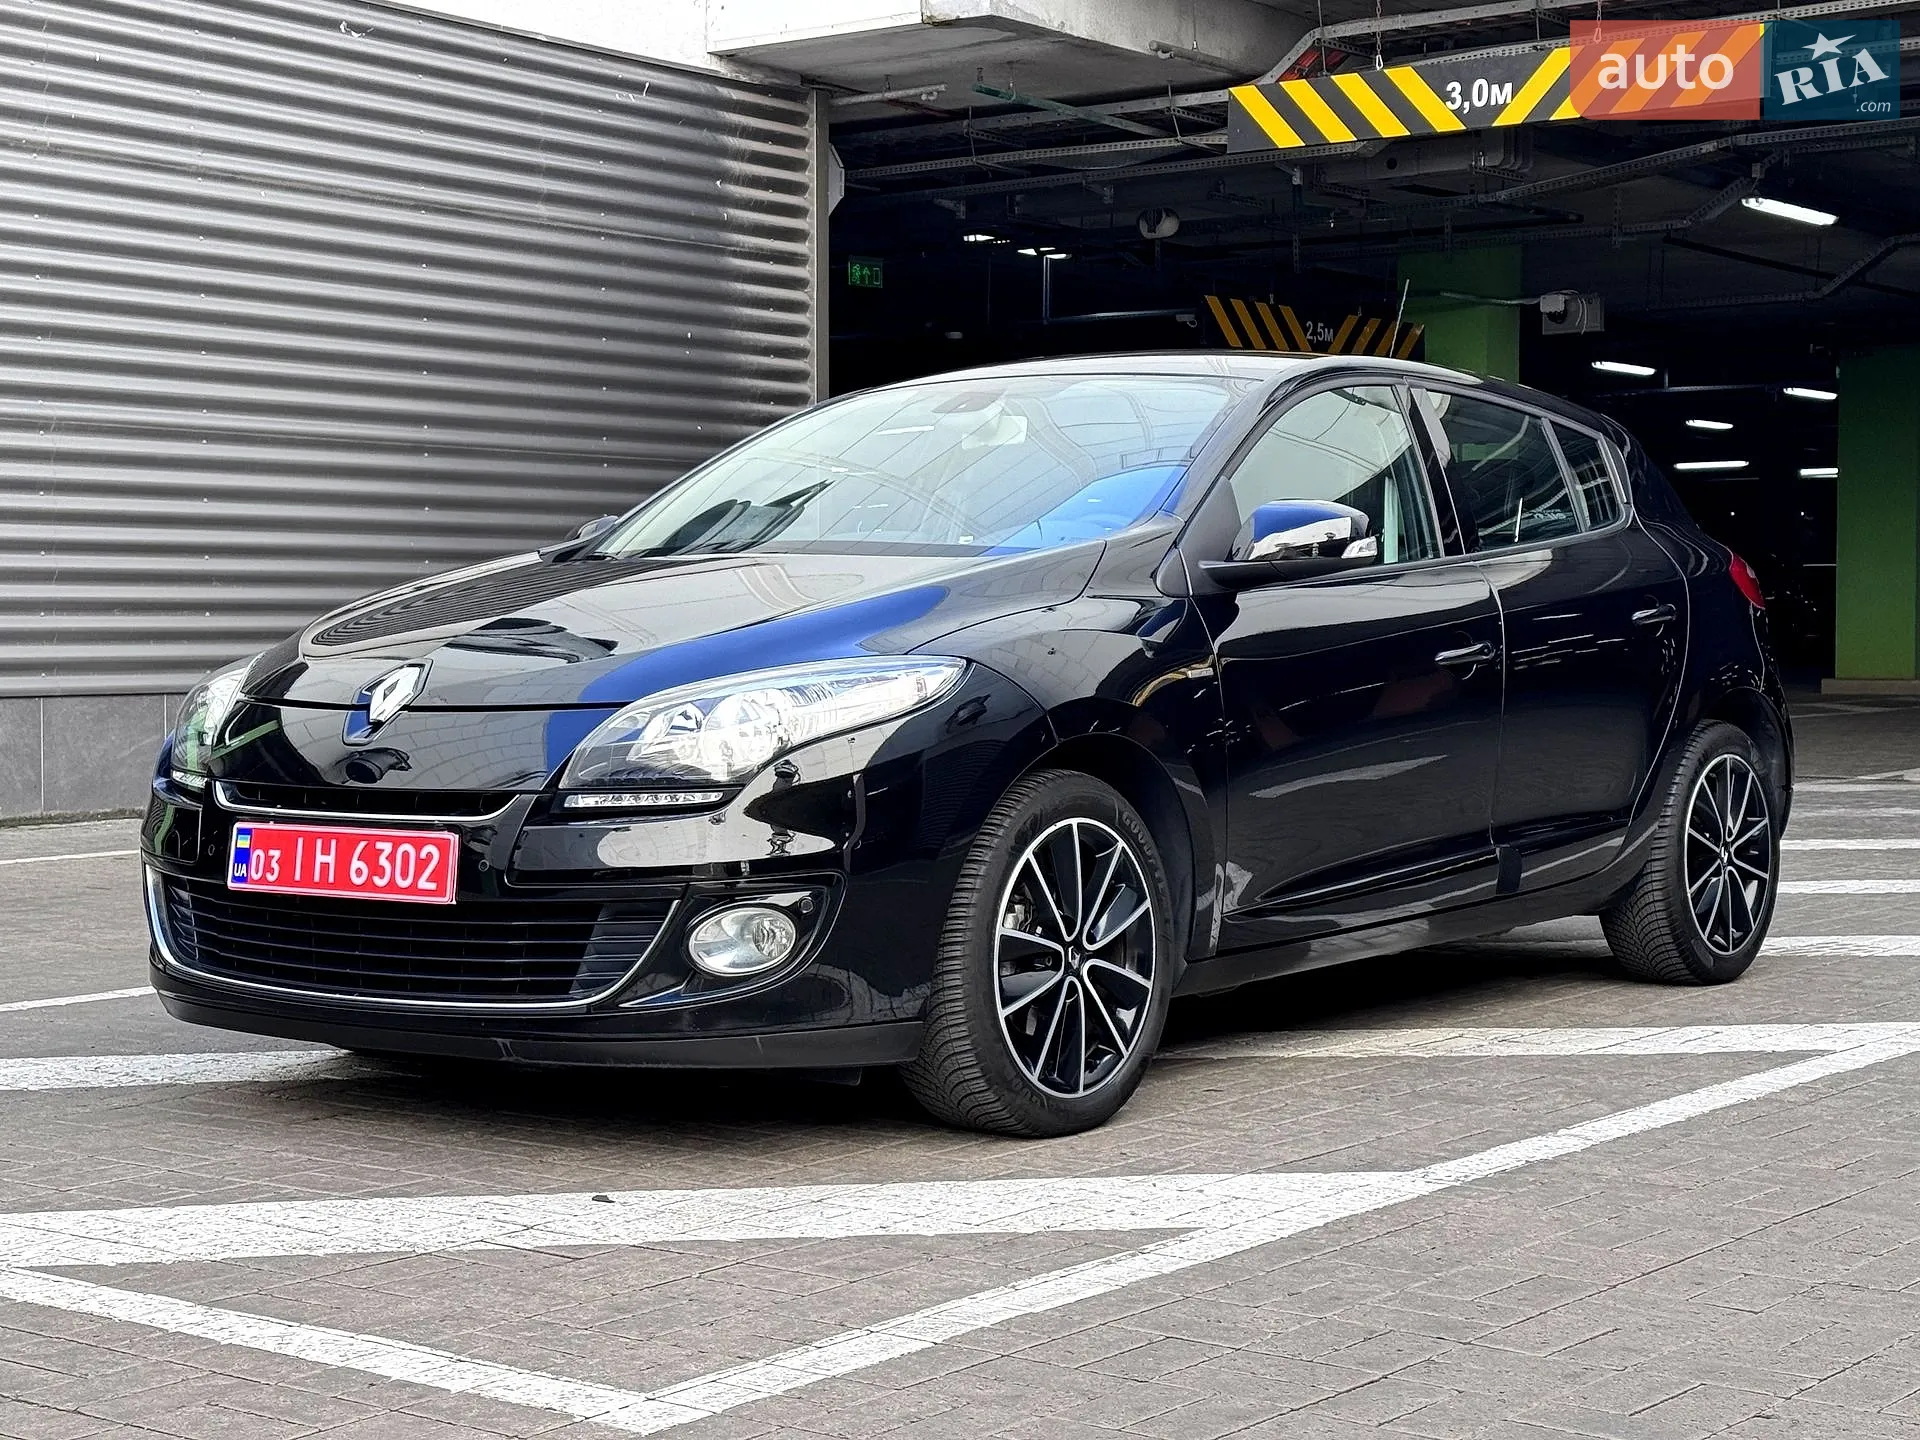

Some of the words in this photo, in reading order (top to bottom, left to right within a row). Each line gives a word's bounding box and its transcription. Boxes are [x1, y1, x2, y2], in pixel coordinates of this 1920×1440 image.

[233, 863, 247, 877] UA
[250, 849, 281, 882] 03
[350, 840, 440, 891] 6302
